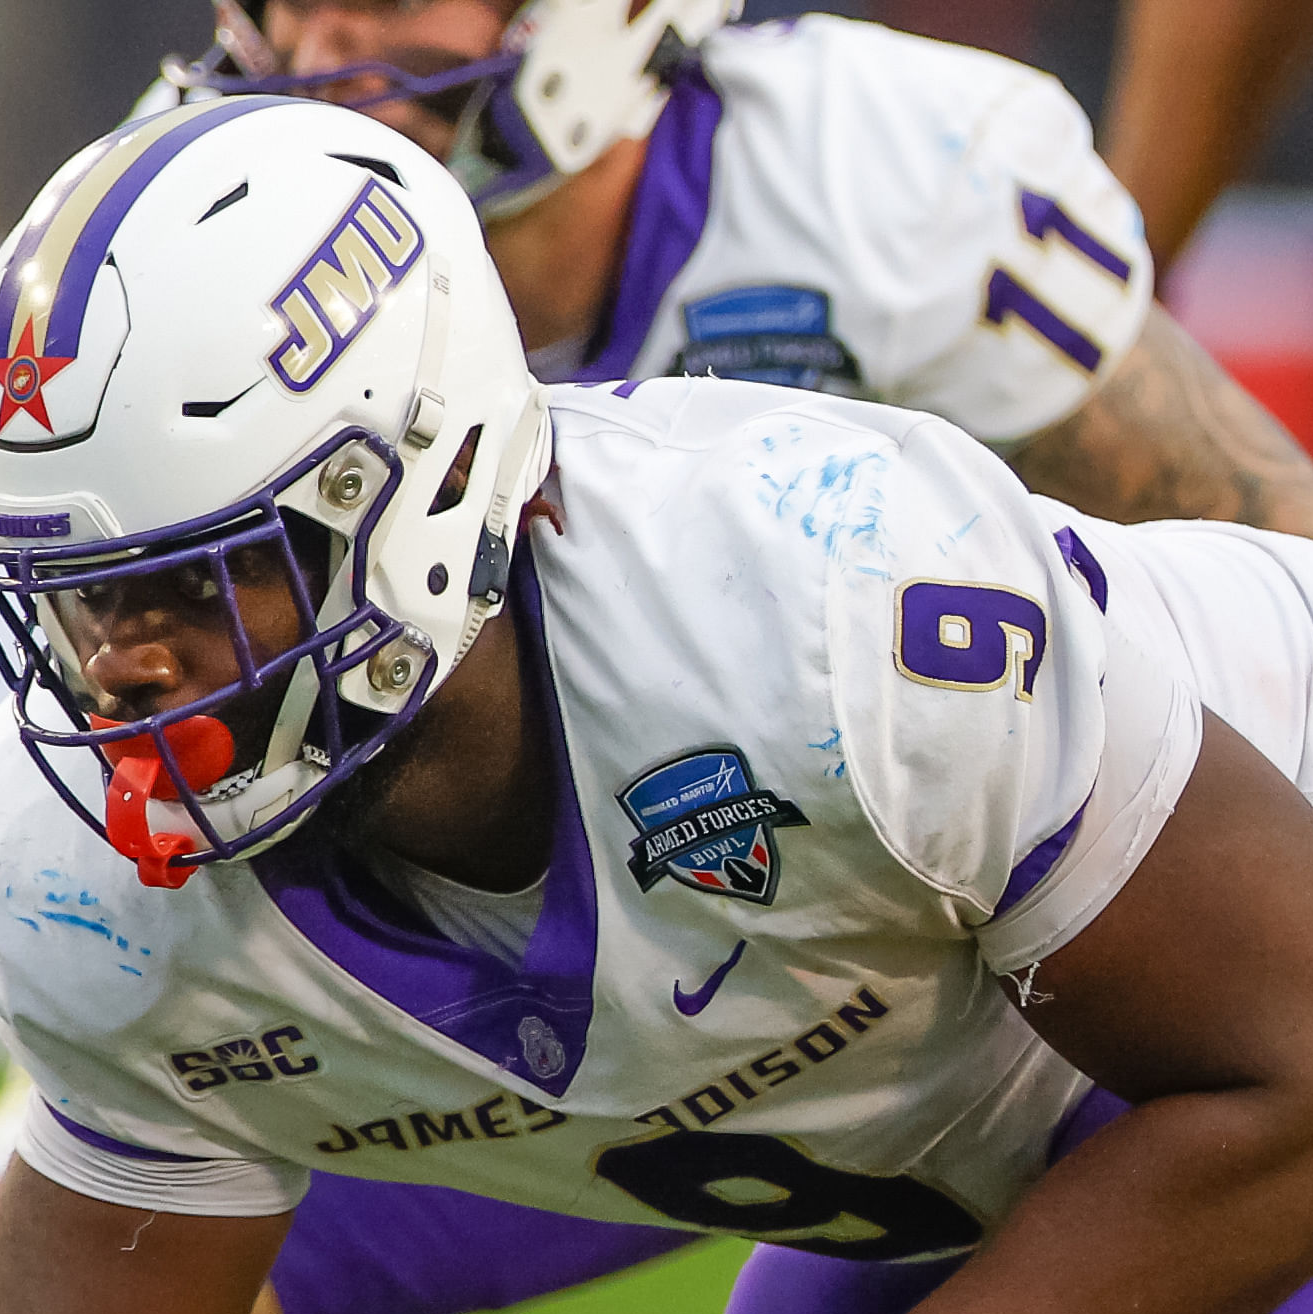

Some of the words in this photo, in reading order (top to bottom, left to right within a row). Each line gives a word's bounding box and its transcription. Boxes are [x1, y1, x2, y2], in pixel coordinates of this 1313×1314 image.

[269, 179, 423, 390] JMU
[985, 187, 1132, 378] 11
[892, 577, 1052, 703] 9
[644, 823, 697, 863] ARMED
[696, 797, 777, 835] FORCES
[689, 837, 746, 867] BOWL
[171, 1026, 319, 1091] SBC
[315, 1095, 569, 1153] JAMES
[633, 987, 890, 1132] ADISON
[593, 1128, 986, 1263] 9
